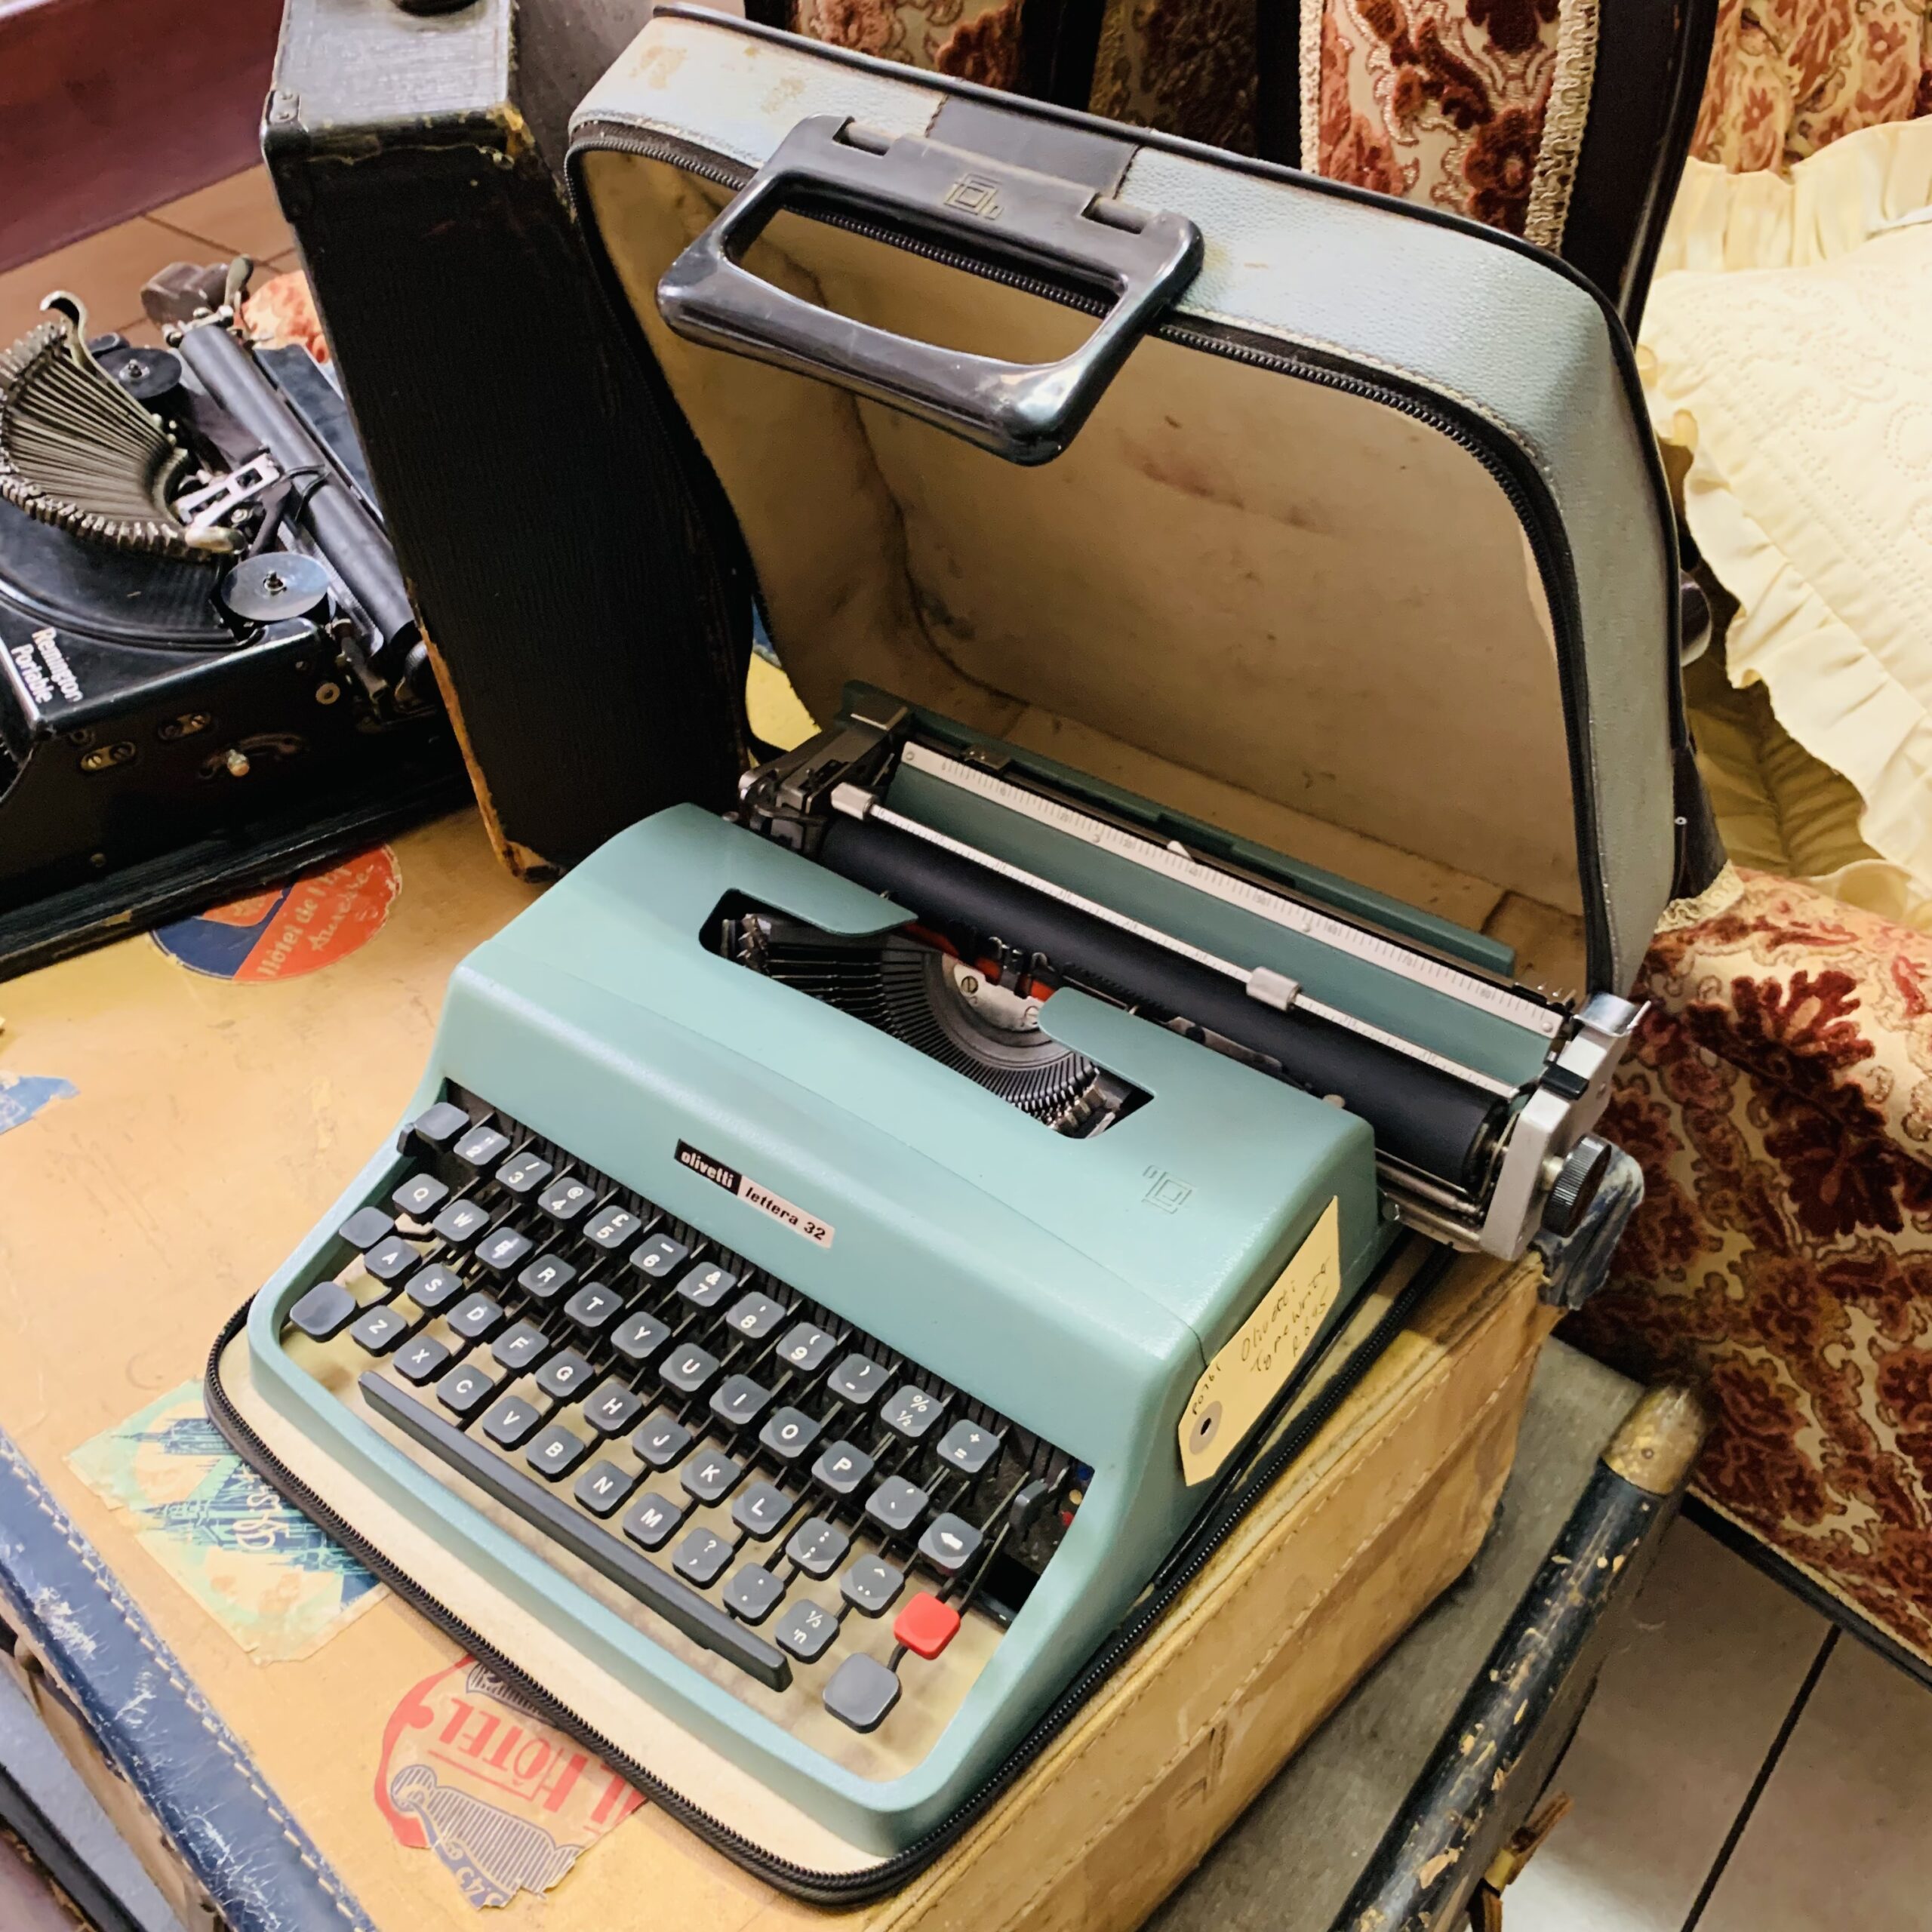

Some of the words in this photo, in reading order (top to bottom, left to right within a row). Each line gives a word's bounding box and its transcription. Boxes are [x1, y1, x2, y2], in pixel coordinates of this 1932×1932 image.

[32, 626, 84, 703] Remington
[11, 643, 55, 703] Portable
[295, 898, 318, 924] de
[465, 1144, 483, 1158] 2
[507, 1171, 525, 1184] 3
[413, 1187, 429, 1202] Q
[566, 1186, 584, 1200] @
[681, 1151, 734, 1189] olivetti
[745, 1186, 799, 1226] lettera
[803, 1221, 826, 1241] 32
[551, 1198, 567, 1211] 4
[453, 1212, 473, 1228] W
[595, 1225, 615, 1239] 5
[381, 1251, 399, 1266] A
[642, 1253, 661, 1268] 6
[537, 1267, 556, 1283] R
[424, 1278, 442, 1292] S
[692, 1282, 709, 1297] 7
[586, 1296, 604, 1311] T
[466, 1306, 485, 1321] D
[368, 1319, 388, 1334] Z
[740, 1315, 757, 1329] 8
[634, 1326, 651, 1340] Y
[509, 1336, 530, 1350] F
[411, 1349, 429, 1364] X
[790, 1346, 808, 1361] 9
[681, 1358, 700, 1374] U
[556, 1366, 574, 1382] G
[456, 1380, 472, 1394] C
[602, 1398, 623, 1415] H
[909, 1394, 931, 1413] %
[503, 1411, 520, 1426] V
[781, 1424, 798, 1439] O
[652, 1432, 671, 1447] J
[545, 1441, 564, 1457] B
[832, 1457, 852, 1471] P
[700, 1464, 720, 1482] K
[592, 1476, 614, 1494] N
[751, 1497, 764, 1516] L
[645, 1511, 664, 1528] M
